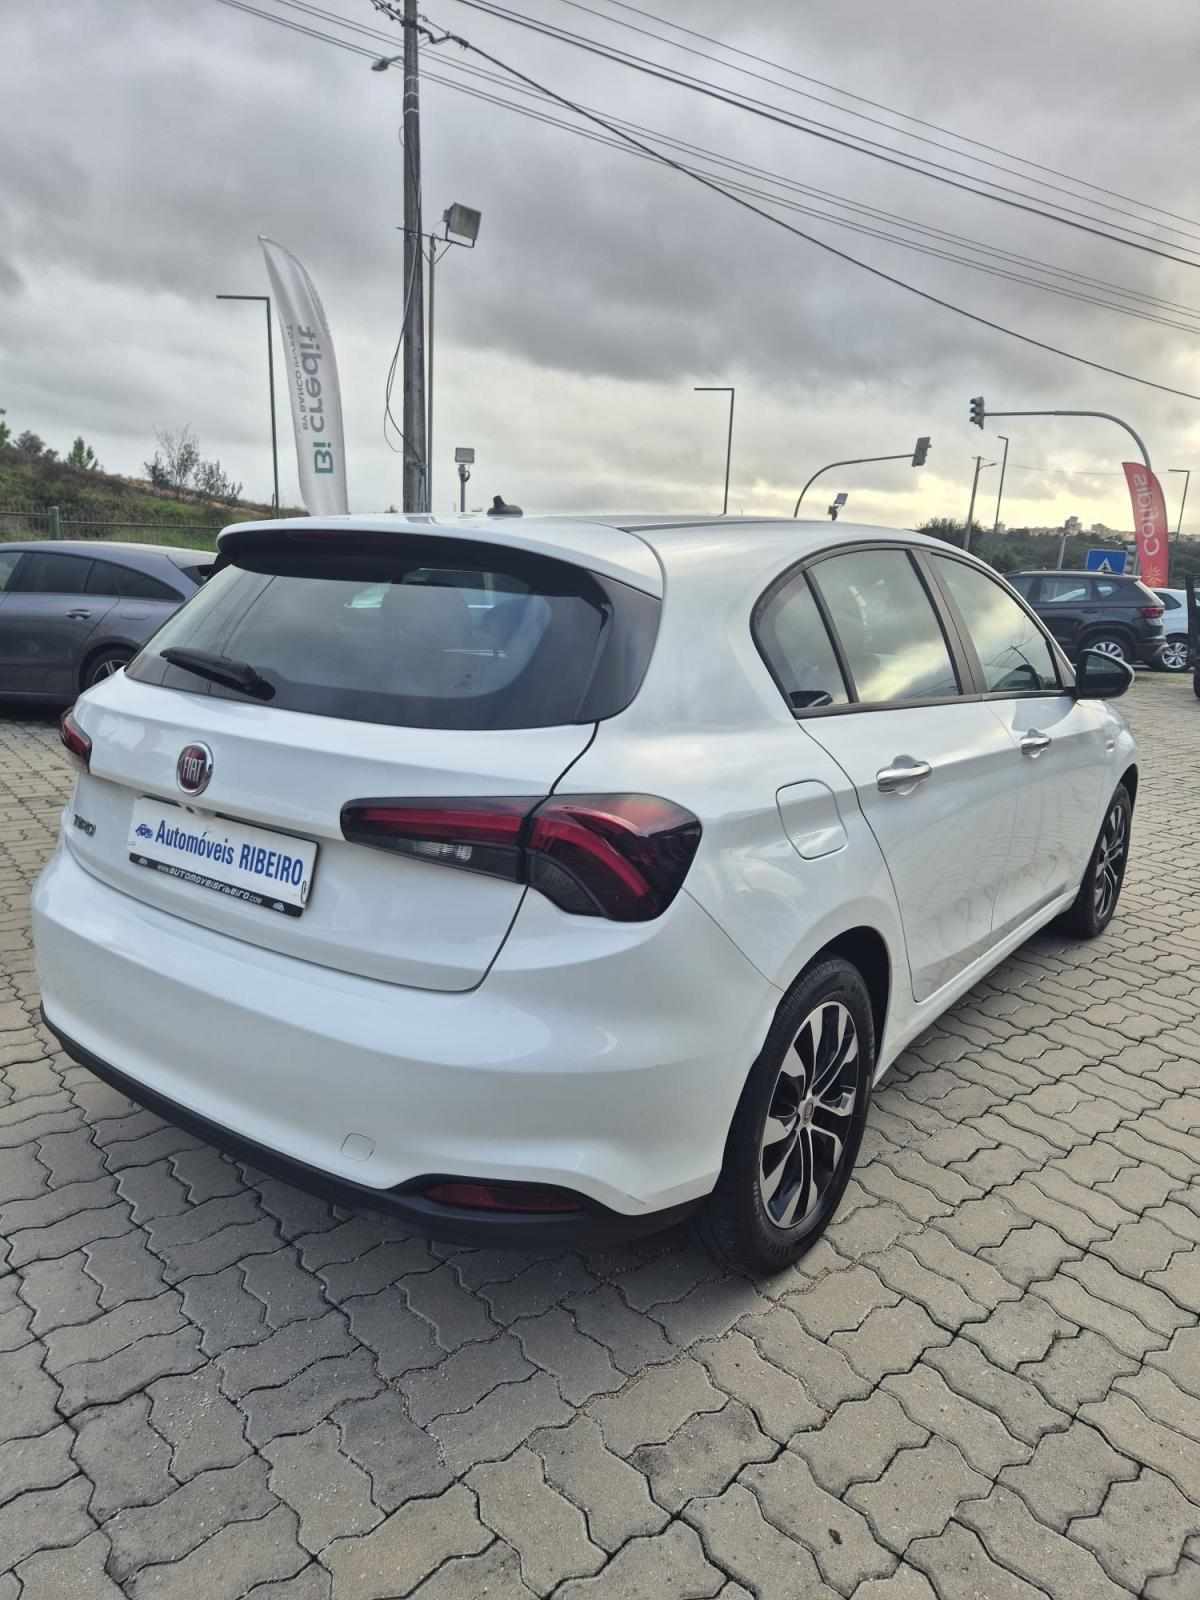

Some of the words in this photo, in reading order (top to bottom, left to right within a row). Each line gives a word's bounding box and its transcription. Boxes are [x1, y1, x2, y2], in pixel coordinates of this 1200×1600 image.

[182, 756, 204, 782] FIAT
[155, 820, 235, 865] Automóveis
[239, 843, 303, 886] RIBEIRO
